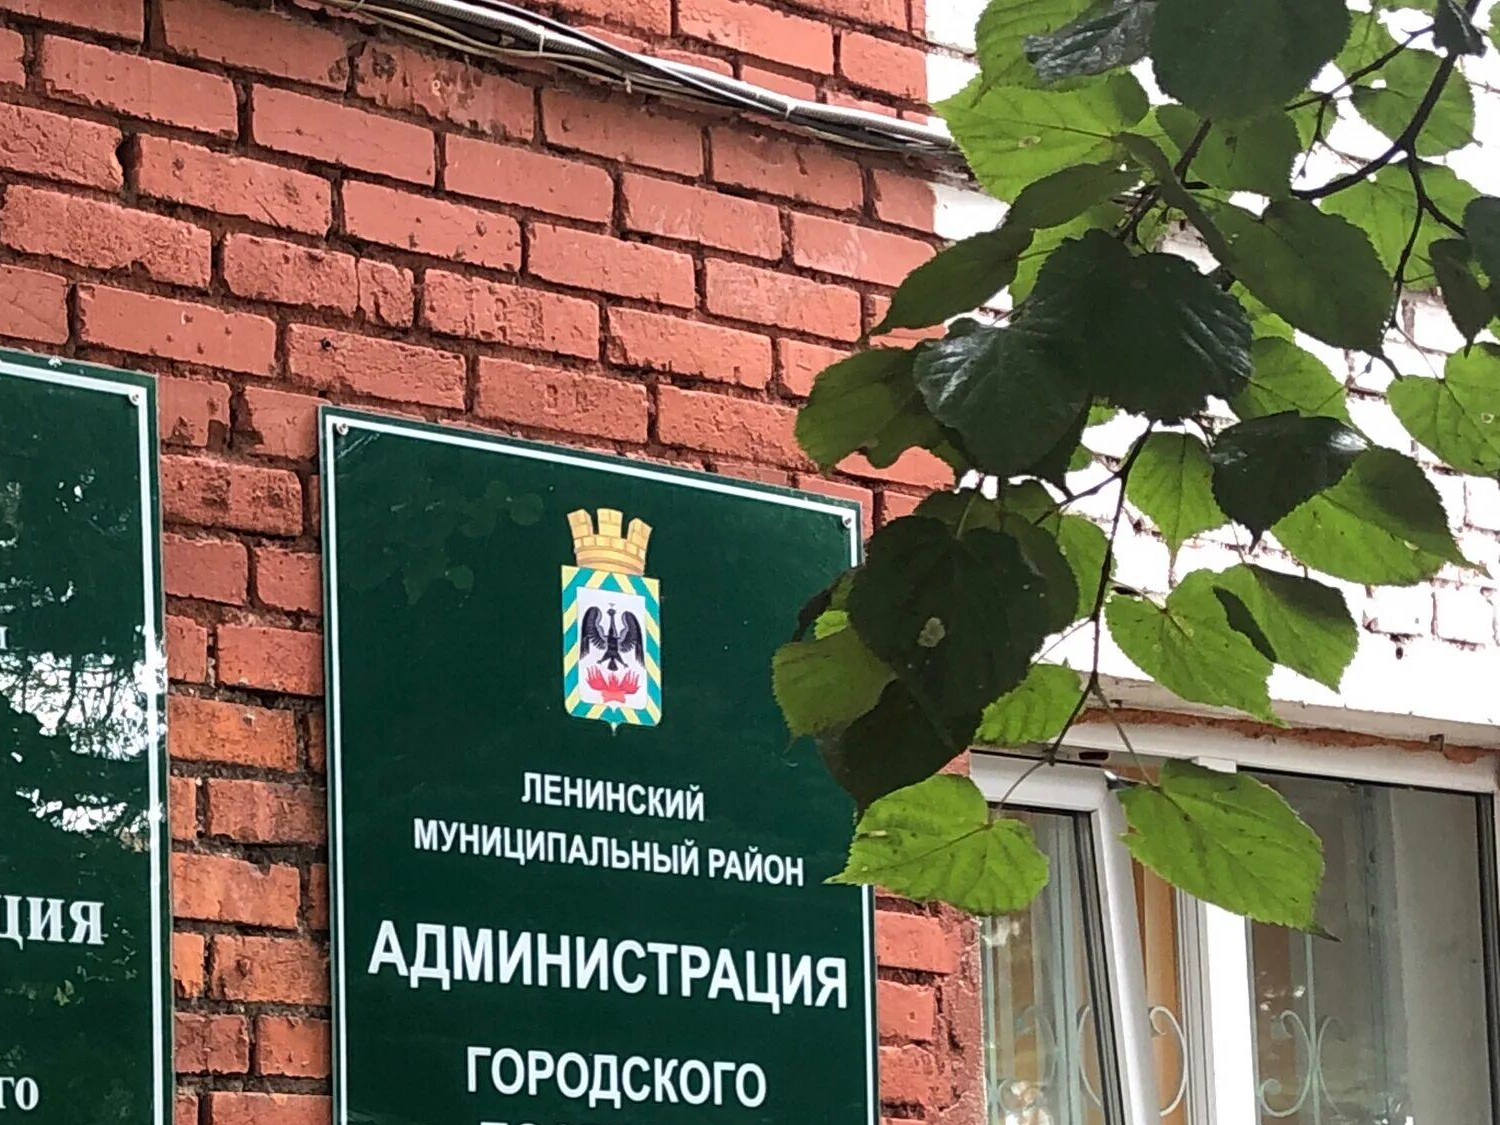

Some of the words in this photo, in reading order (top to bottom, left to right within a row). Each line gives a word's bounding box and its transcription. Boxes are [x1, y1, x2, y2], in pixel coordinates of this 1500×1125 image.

[521, 772, 704, 822] ЛЕНИНСКИЙ
[414, 818, 699, 876] МУНИЦИПАЛЬНЫЙ
[708, 847, 804, 887] РАЙОН
[367, 920, 847, 1015] АДМИНИСТРАЦИЯ
[467, 1046, 767, 1109] ГОРОДСКОГО
